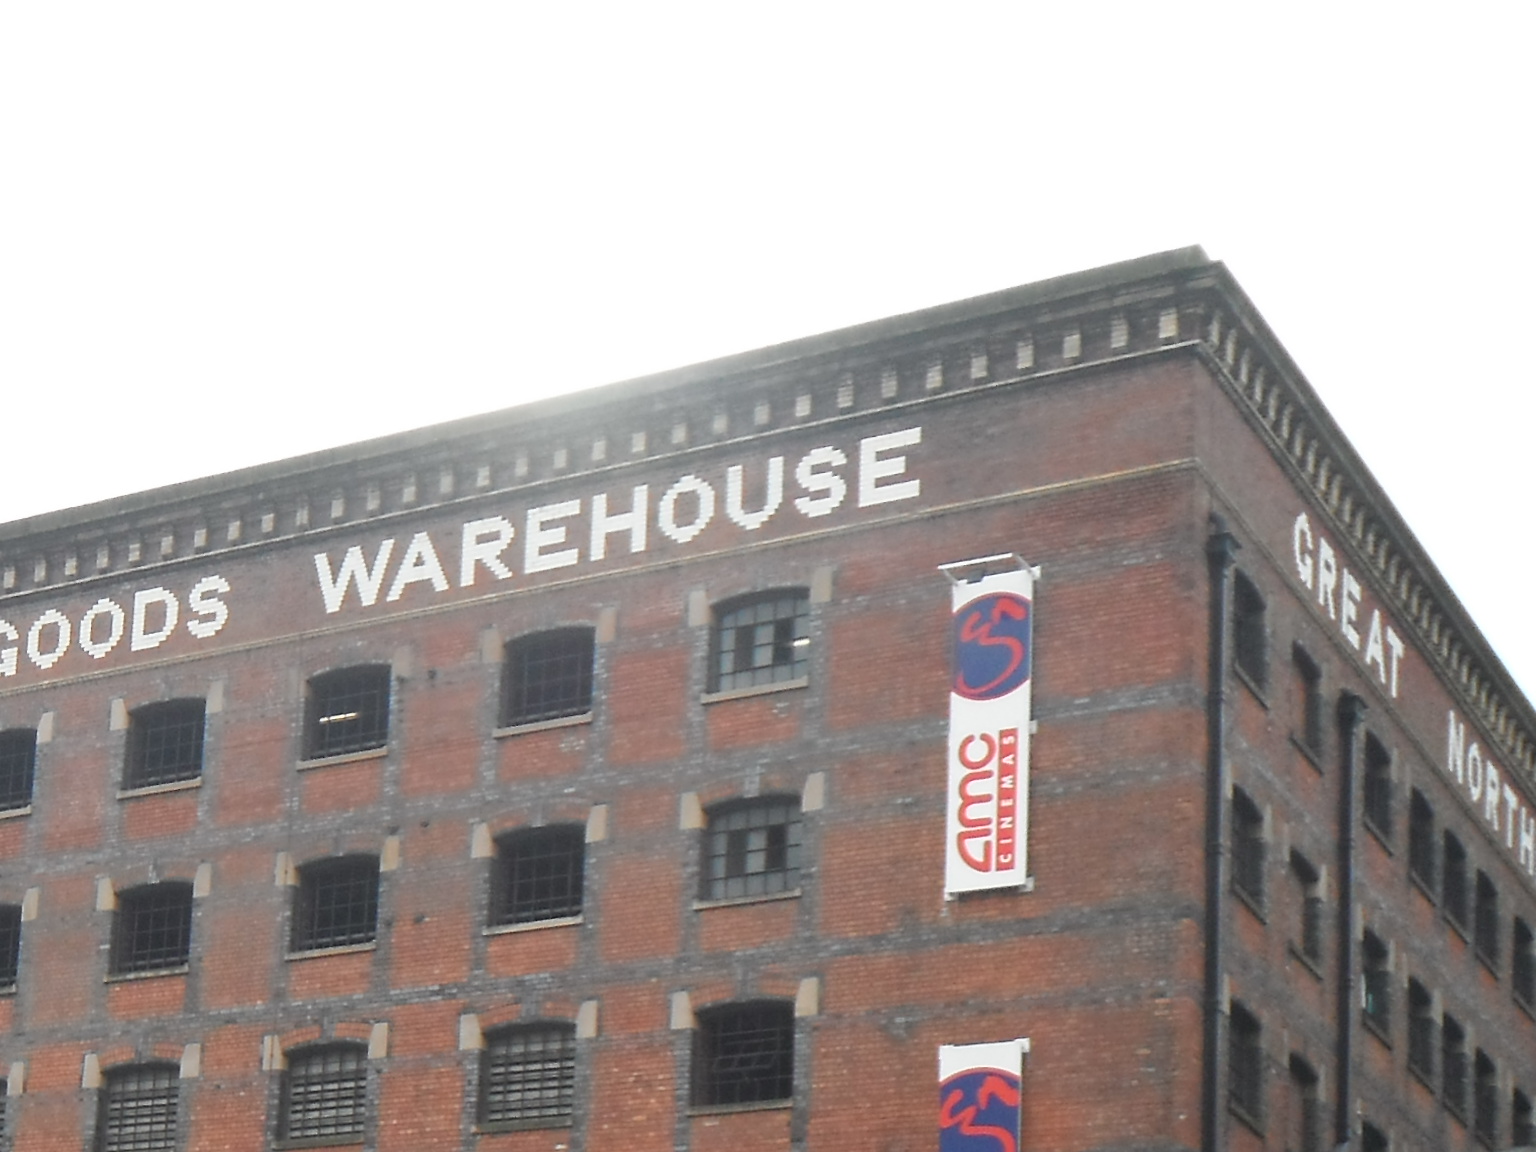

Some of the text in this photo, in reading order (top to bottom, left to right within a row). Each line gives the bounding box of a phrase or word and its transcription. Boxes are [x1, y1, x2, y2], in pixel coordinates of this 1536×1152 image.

[313, 426, 923, 615] WAREHOUSE
[1292, 511, 1406, 699] GREAT
[957, 732, 997, 873] amc
[999, 734, 1015, 863] CINEMAS
